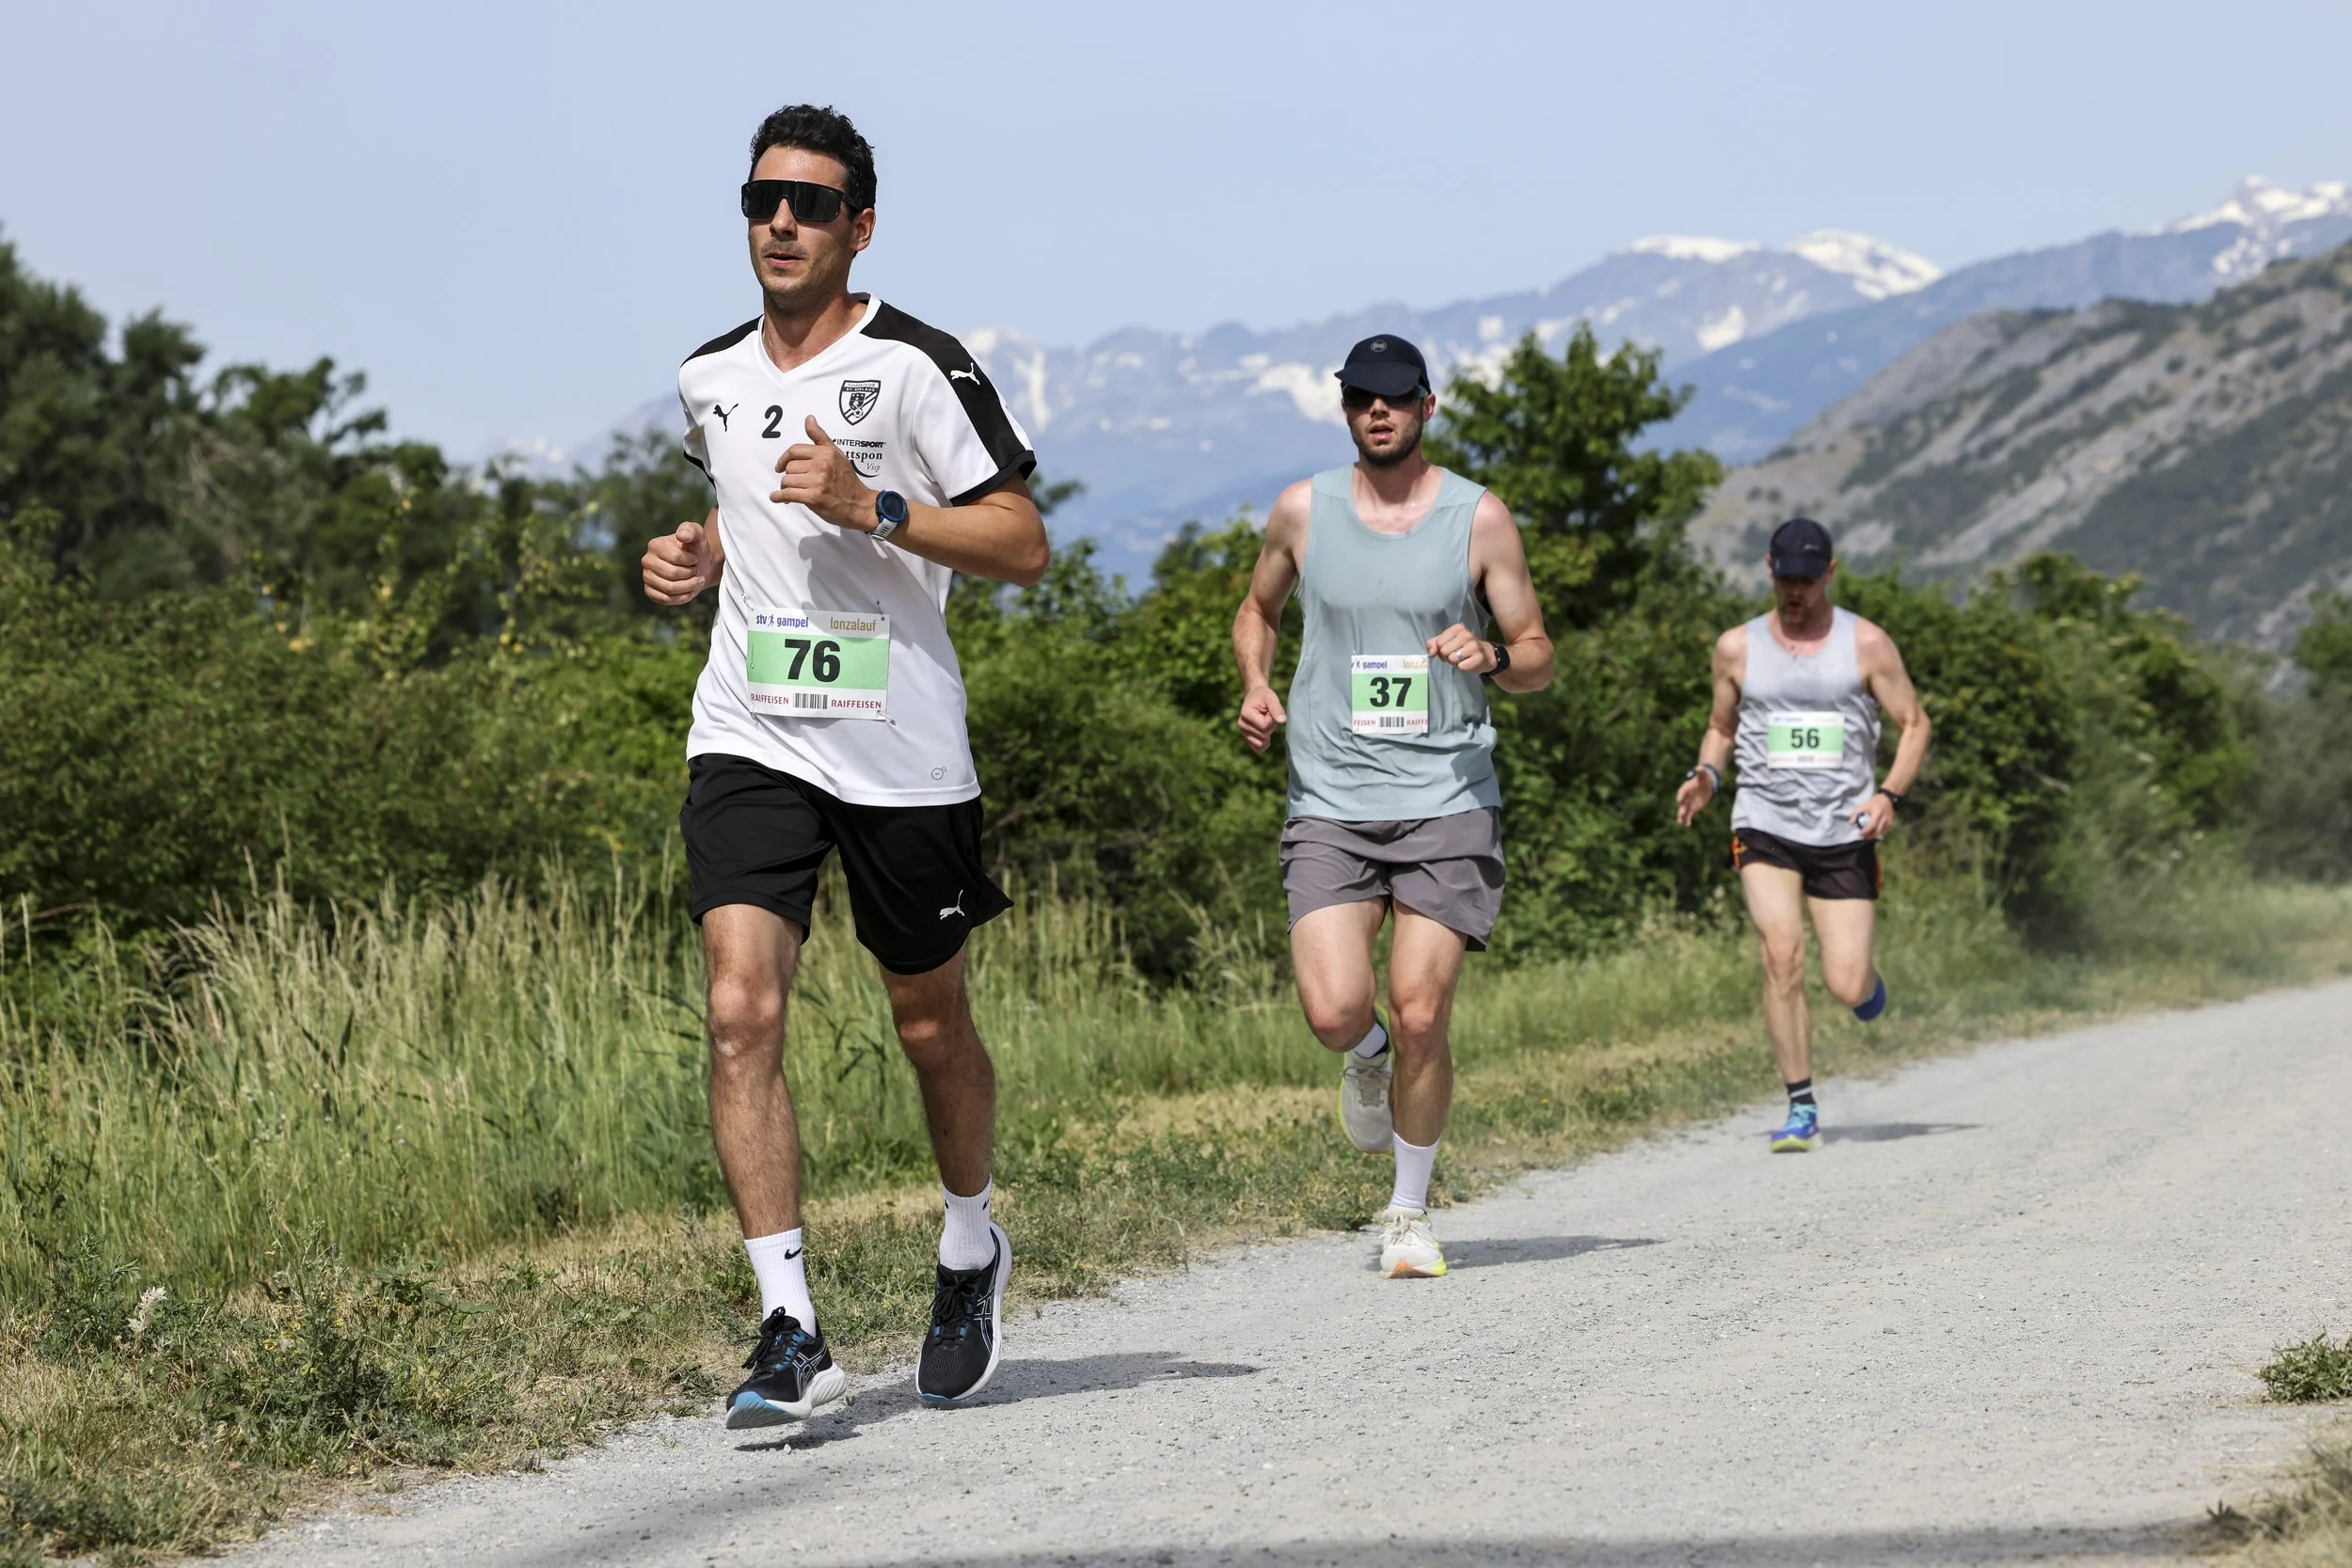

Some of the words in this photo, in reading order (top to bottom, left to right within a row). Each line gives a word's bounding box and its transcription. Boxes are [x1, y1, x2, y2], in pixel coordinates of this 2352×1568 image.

[762, 404, 783, 438] 2
[836, 438, 884, 449] INTERSPORT
[846, 451, 882, 463] ttspon
[866, 463, 881, 472] Visp
[755, 614, 768, 626] stv
[776, 616, 809, 628] gampel
[830, 617, 877, 632] lonzalauf
[784, 639, 841, 683] 76
[1362, 660, 1388, 670] gampel
[1370, 676, 1412, 707] 37
[751, 693, 789, 705] RAIFFEISEN
[831, 699, 882, 709] RAIFFEISEN
[1790, 728, 1820, 749] 56
